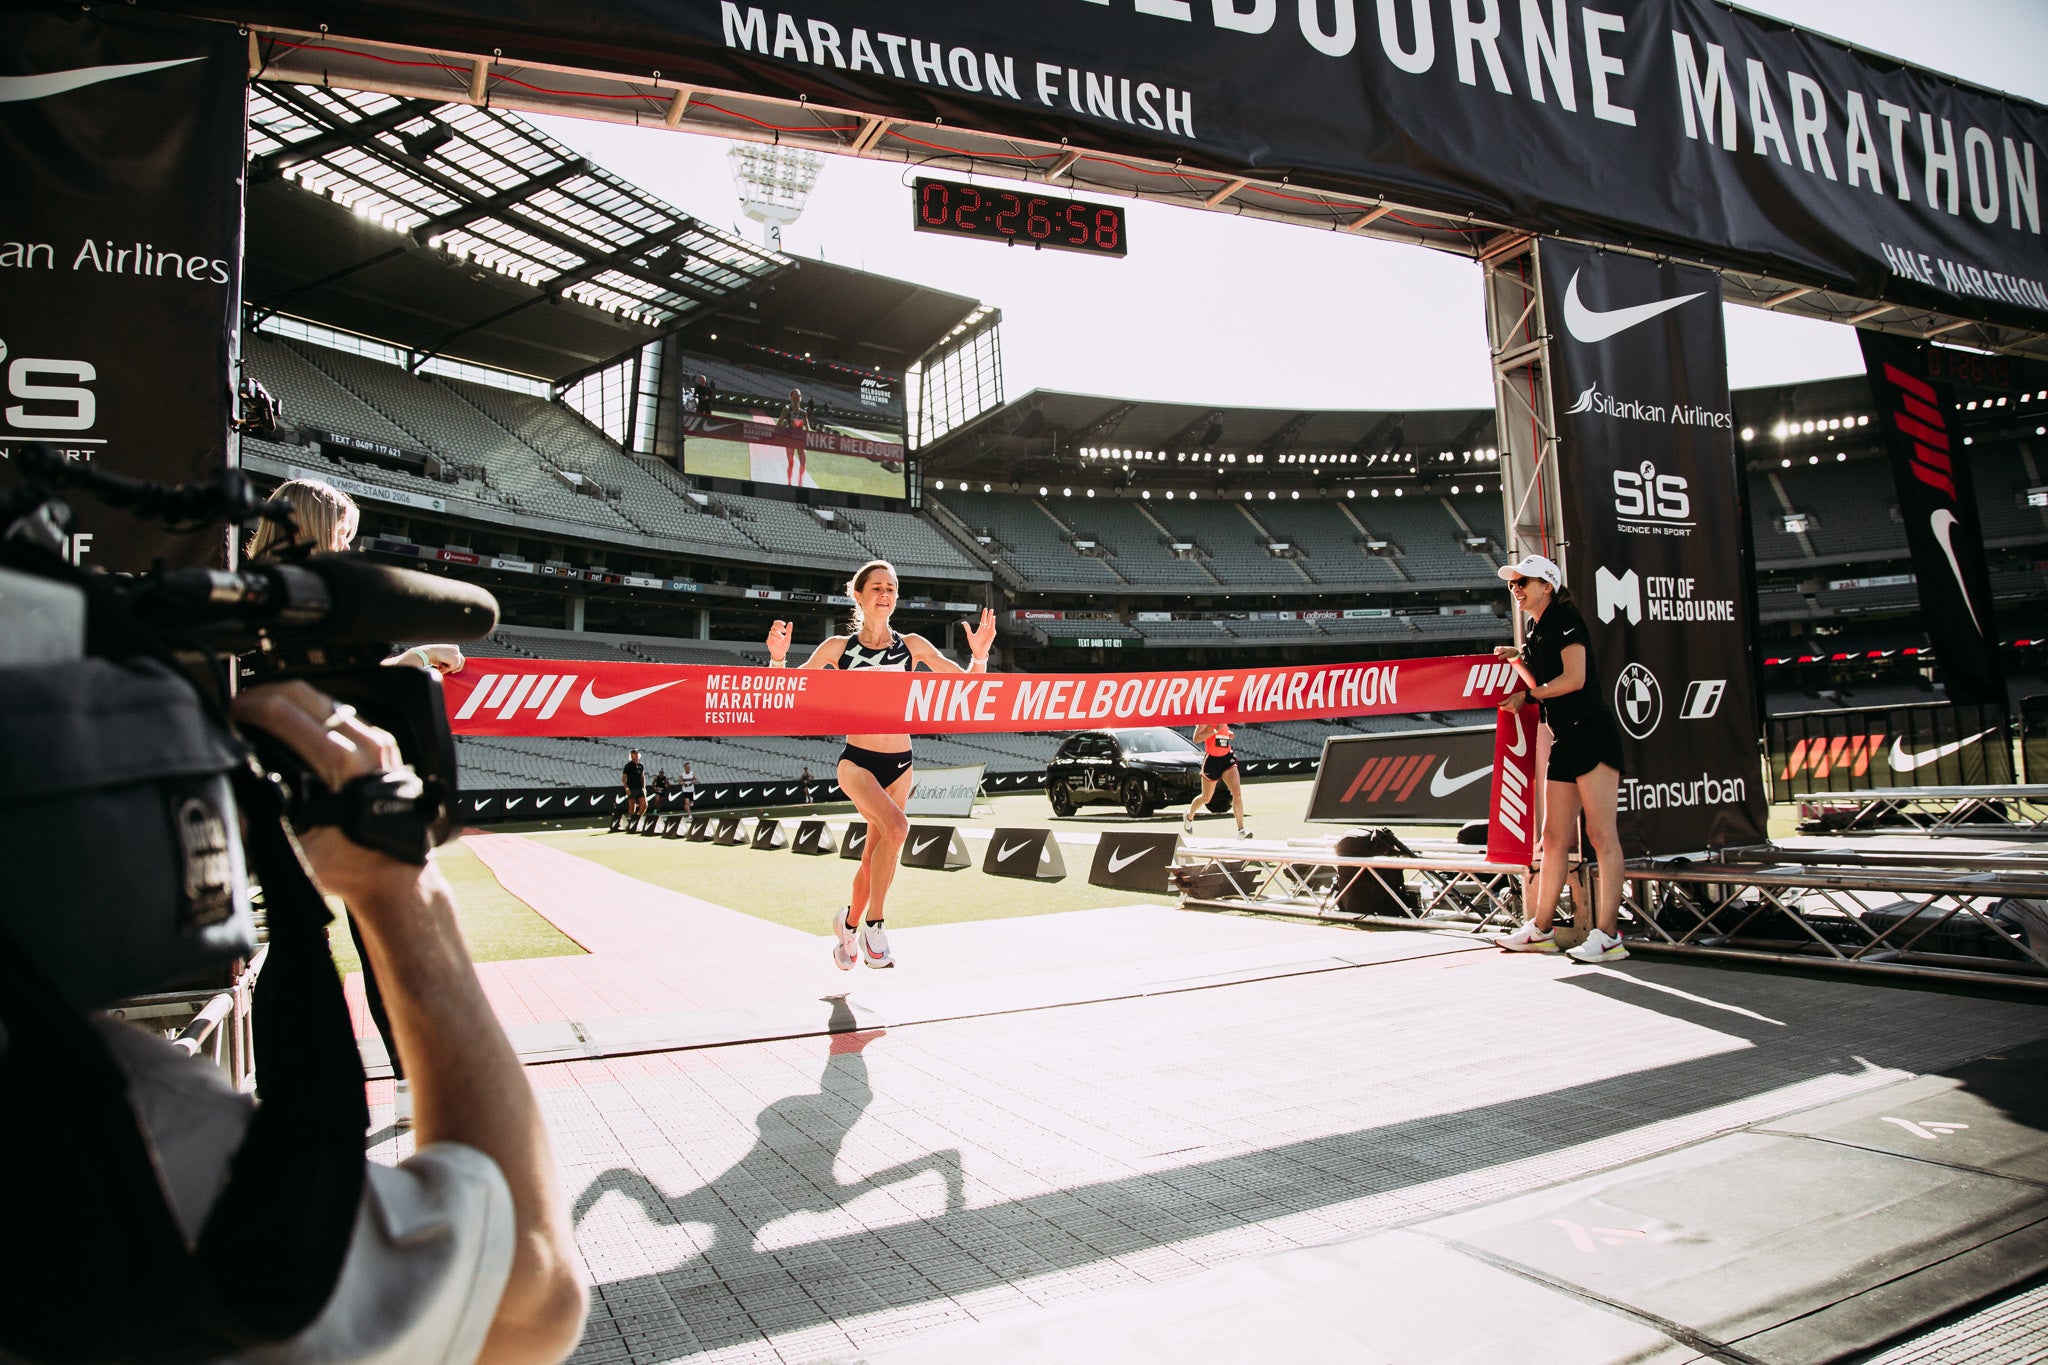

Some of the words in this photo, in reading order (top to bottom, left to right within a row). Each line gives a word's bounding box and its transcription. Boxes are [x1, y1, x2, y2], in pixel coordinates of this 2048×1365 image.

[720, 0, 1022, 100] MARATHON
[1036, 61, 1197, 139] FINISH
[1671, 29, 2041, 235] MARATHON
[922, 183, 1119, 249] 02:26:58
[72, 238, 229, 284] Airlines
[1880, 242, 1936, 286] HALF
[1937, 258, 2048, 310] MARATHON
[1593, 392, 1666, 423] SriLankan
[1671, 404, 1732, 429] Airlines
[330, 433, 351, 445] TEXT
[355, 439, 373, 451] 0409
[805, 432, 836, 451] NIKE
[326, 476, 361, 493] OLYMPIC
[363, 483, 391, 500] STAND
[392, 491, 411, 504] 2006
[1617, 524, 1651, 534] SCIENCE
[1652, 526, 1662, 534] IN
[1663, 527, 1692, 536] SPORT
[673, 582, 697, 592] OPTUS
[1646, 576, 1674, 598] CITY
[1678, 577, 1695, 597] OF
[1025, 611, 1055, 619] Cummins
[1303, 610, 1338, 620] Ladbrokes
[1648, 599, 1735, 622] MELBOURNE
[1077, 638, 1090, 648] TEXT
[706, 674, 808, 691] MELBOURNE
[904, 679, 1004, 722] NIKE
[1010, 675, 1236, 721] MELBOURNE
[1237, 665, 1400, 713] MARATHON
[705, 692, 795, 709] MARATHON
[705, 711, 756, 724] FESTIVAL
[1622, 772, 1746, 811] Transurban
